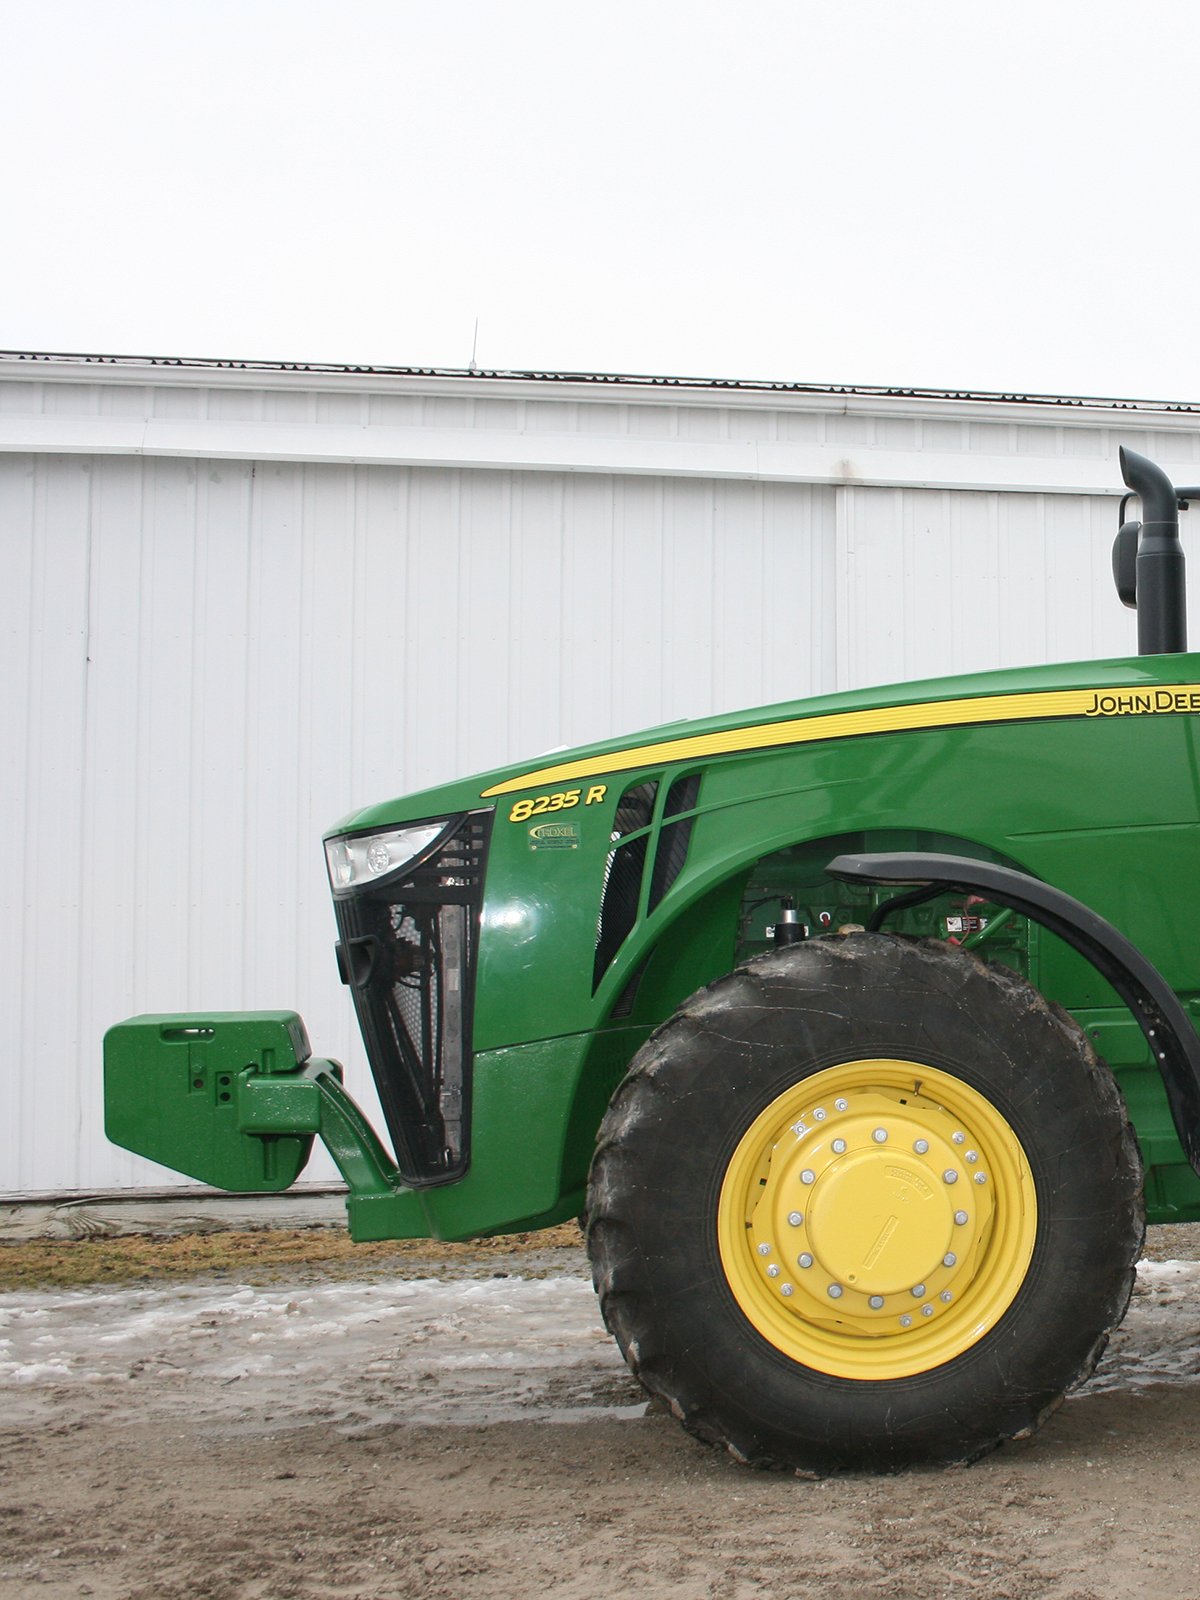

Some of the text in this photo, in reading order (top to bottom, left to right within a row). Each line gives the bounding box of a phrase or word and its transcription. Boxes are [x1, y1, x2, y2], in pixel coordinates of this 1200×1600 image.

[1086, 693, 1150, 714] JOHN
[509, 784, 607, 823] 8235 R
